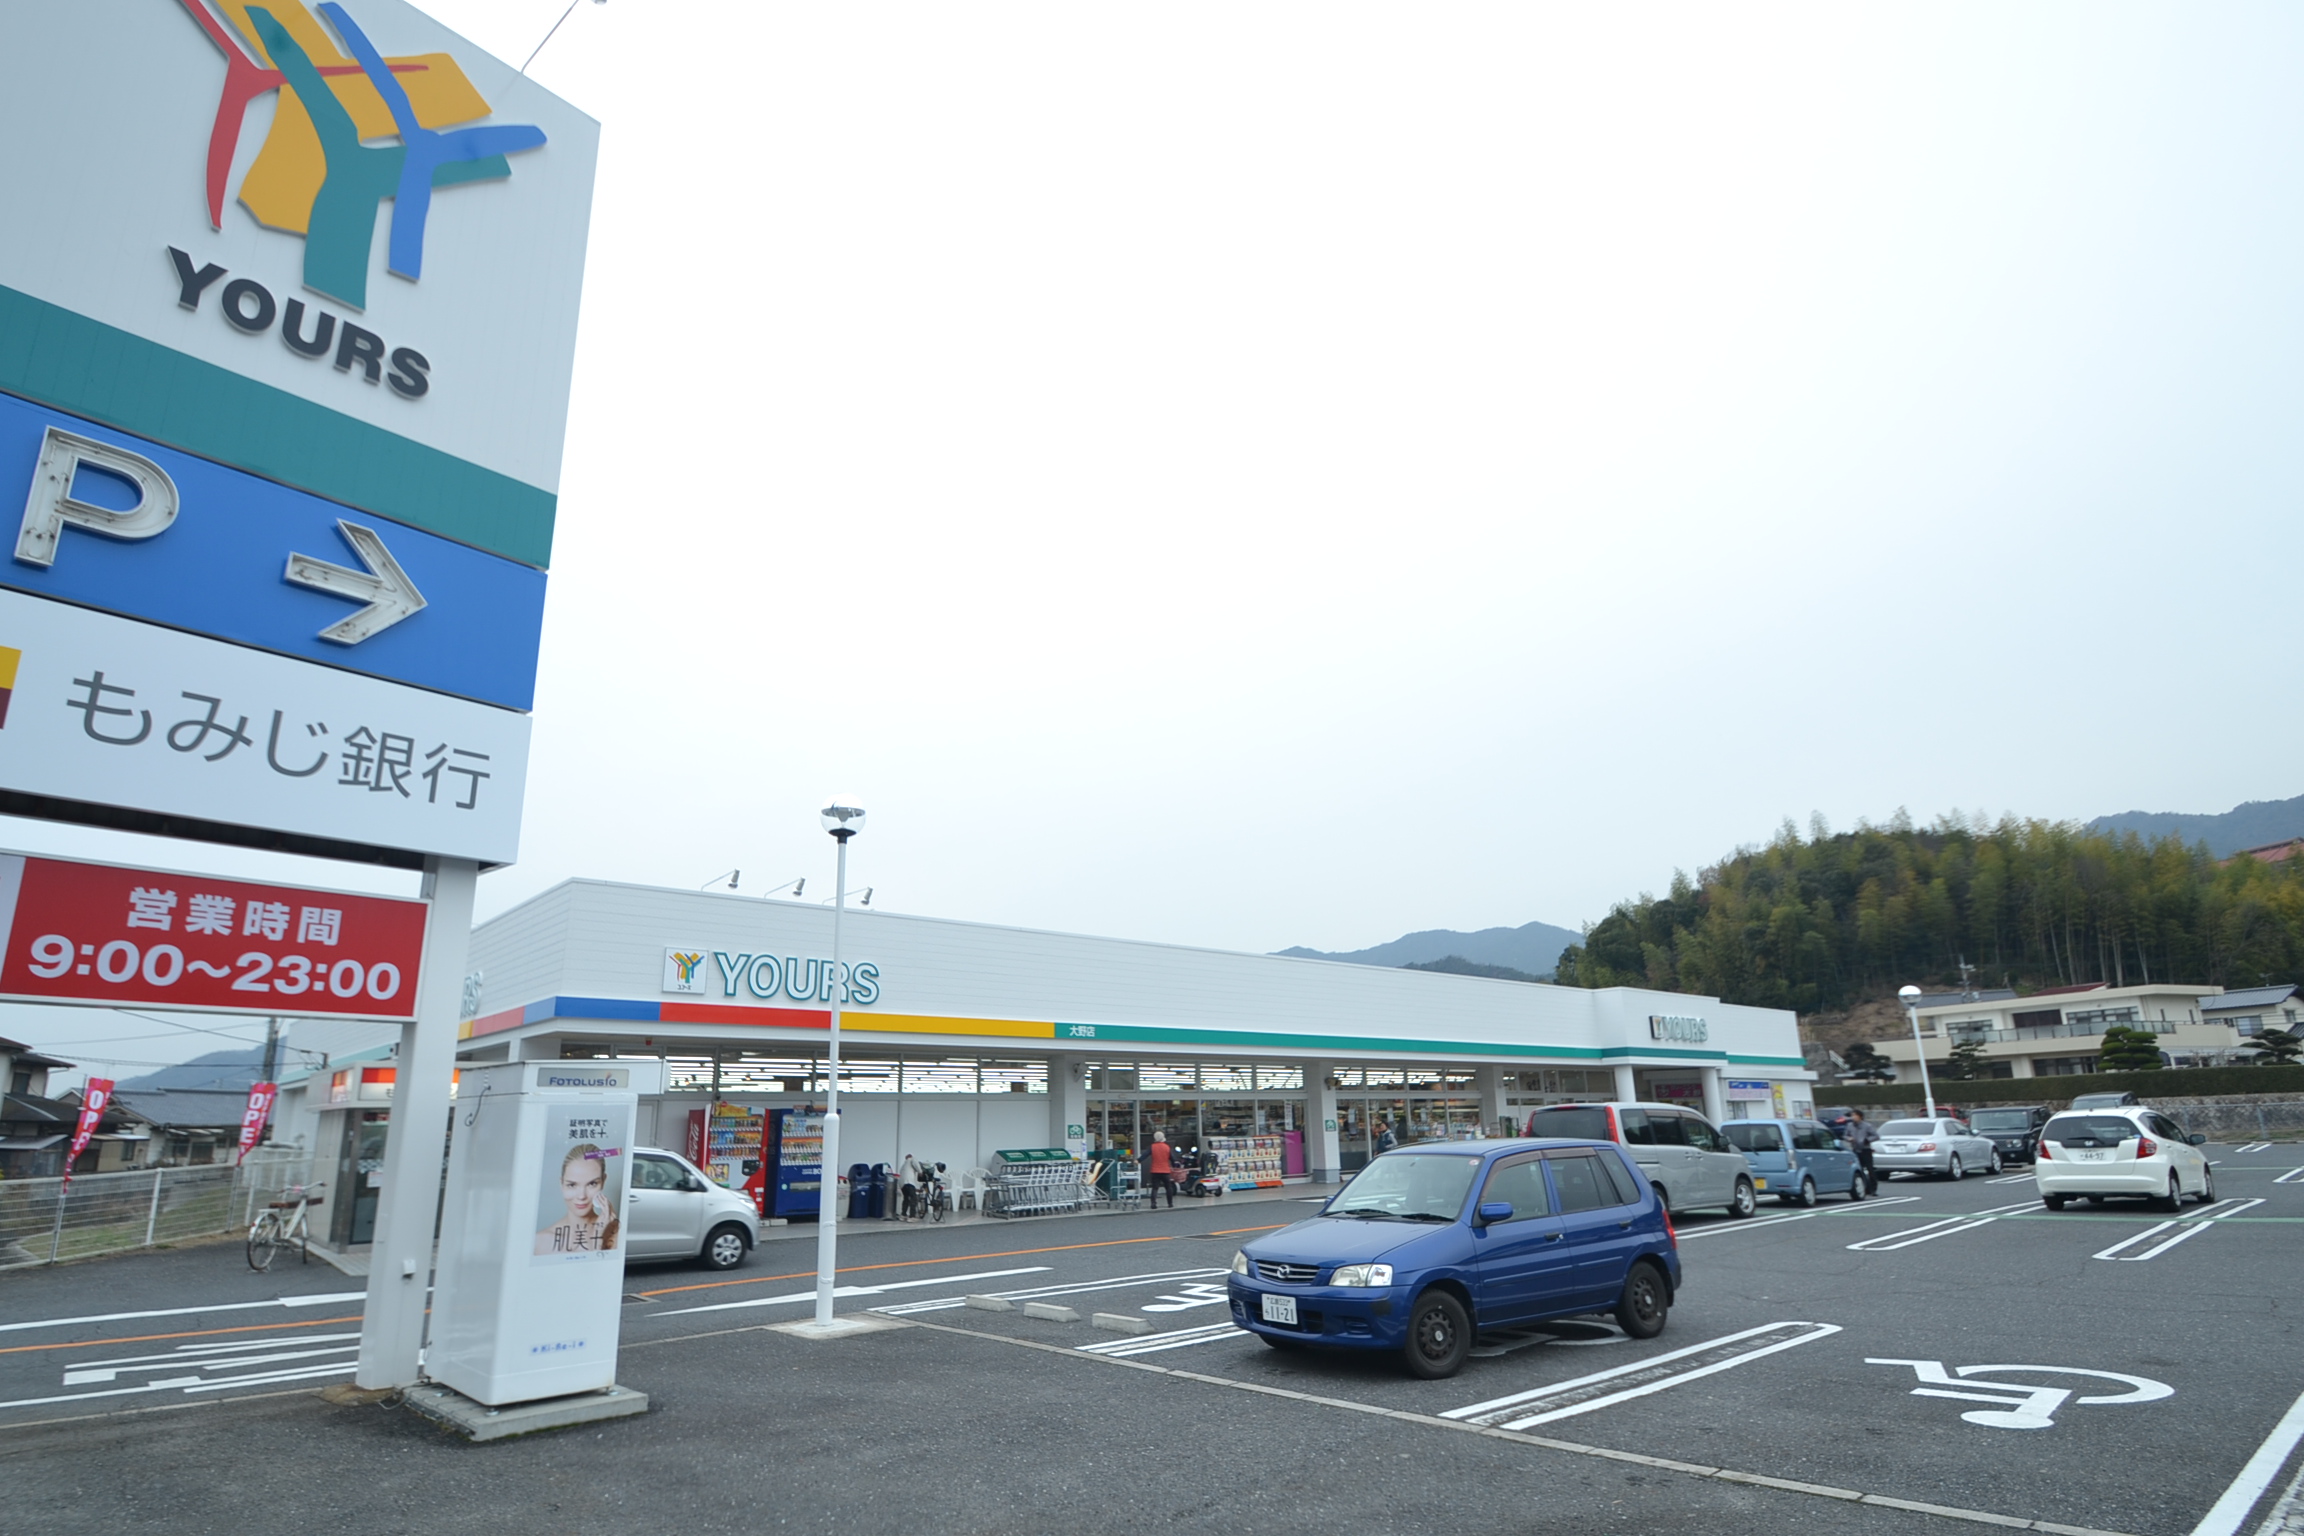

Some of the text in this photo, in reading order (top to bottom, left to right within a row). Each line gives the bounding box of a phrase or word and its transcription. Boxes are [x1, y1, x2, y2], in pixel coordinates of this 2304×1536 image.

[166, 244, 432, 400] YOURS
[14, 425, 180, 567] P
[66, 671, 491, 810] もみじ銀行
[126, 886, 343, 946] 営業時間
[713, 952, 880, 1005] YOURS
[1069, 1024, 1097, 1038] 大野店
[1661, 1015, 1709, 1043] YOURS
[1270, 1305, 1295, 1322] 11-21
